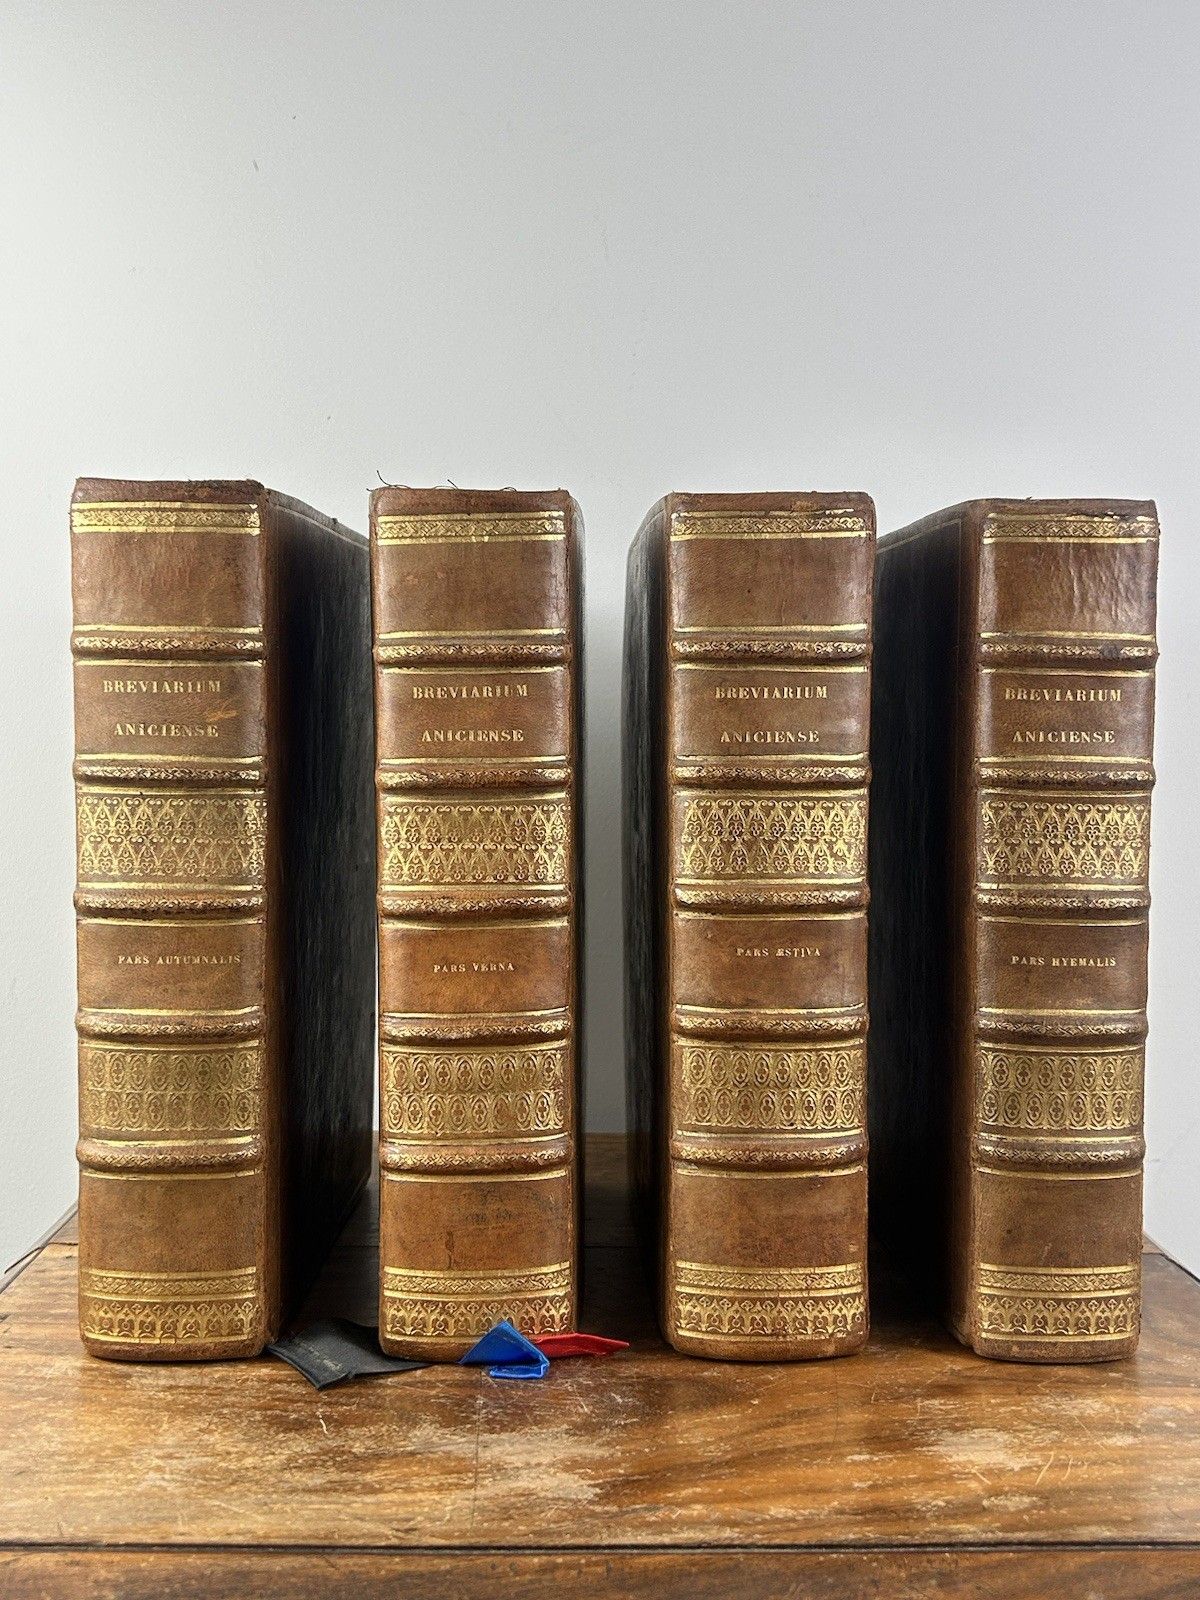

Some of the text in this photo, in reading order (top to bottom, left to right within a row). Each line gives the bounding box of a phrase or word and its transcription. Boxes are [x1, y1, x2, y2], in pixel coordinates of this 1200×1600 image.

[102, 679, 221, 694] BREVIARIUM
[412, 684, 528, 699] BREVIARIUM
[715, 685, 828, 699] BREVIARIUM
[1004, 687, 1121, 702] BREVIARIUM
[114, 723, 219, 737] ANICIENSE
[421, 729, 524, 742] ANICIENSE
[720, 730, 820, 743] ANICIENSE
[1012, 730, 1115, 743] ANICIENSE
[735, 947, 769, 957] PARS
[117, 955, 150, 965] PARS
[1011, 955, 1117, 967] PARS HYEMALIS
[432, 962, 514, 973] PARS VERNA
